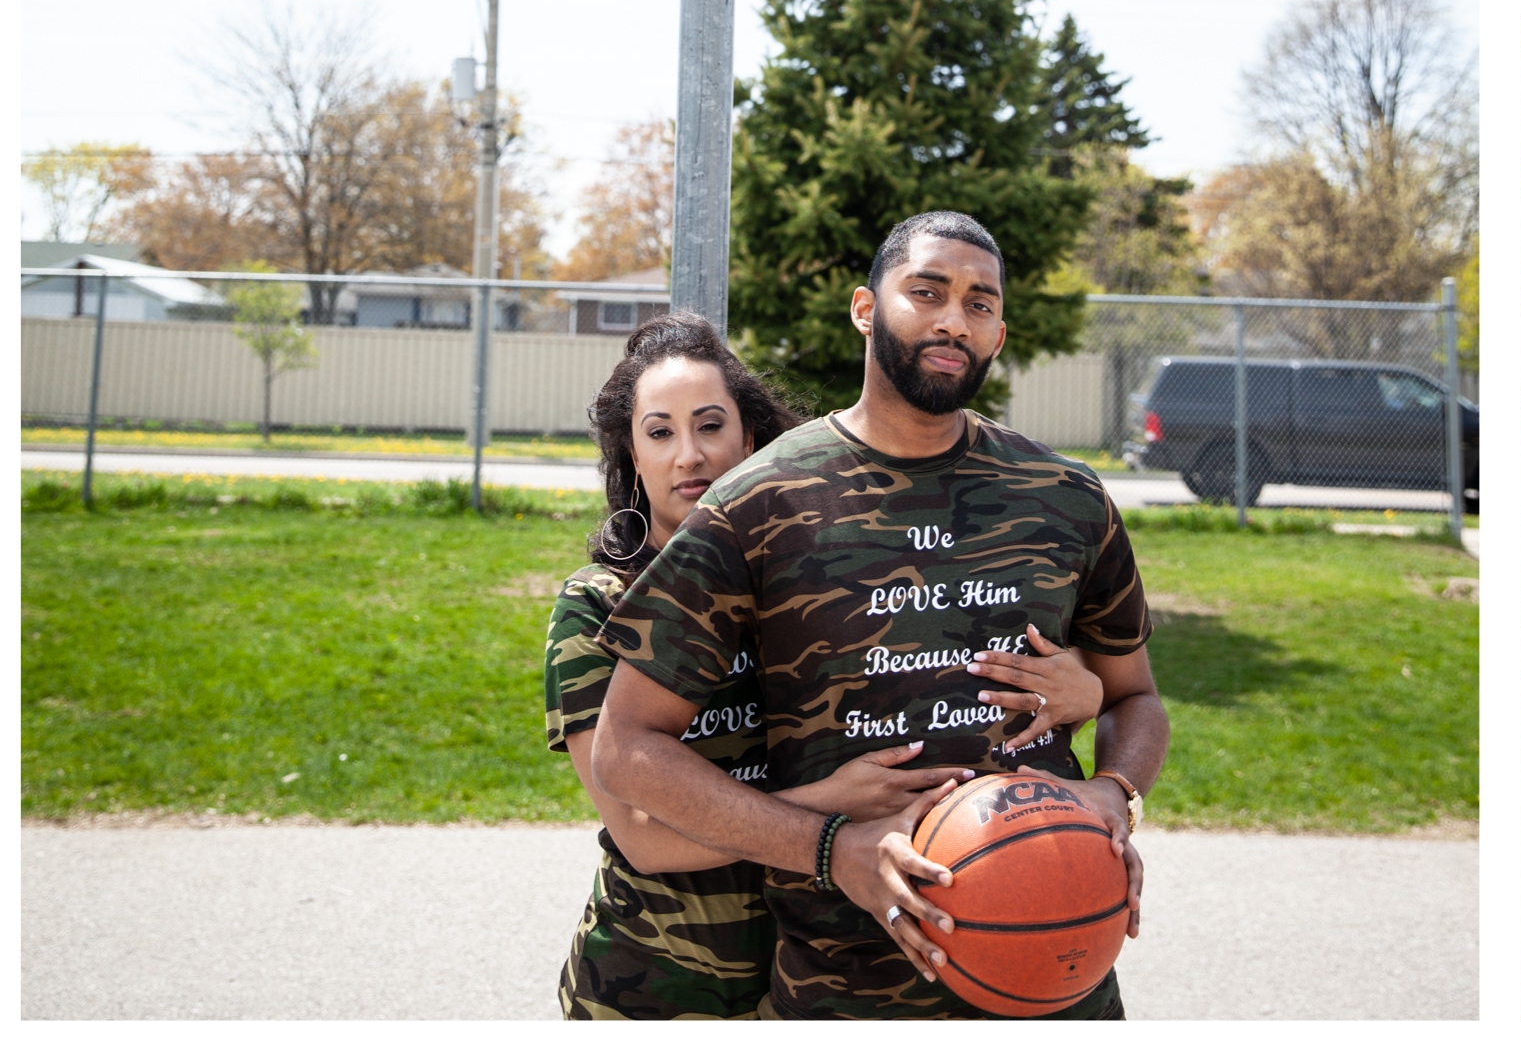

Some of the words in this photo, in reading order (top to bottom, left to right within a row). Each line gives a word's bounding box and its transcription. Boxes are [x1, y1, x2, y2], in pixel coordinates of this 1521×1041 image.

[907, 525, 955, 550] We
[866, 583, 950, 616] LOVE
[957, 580, 1021, 608] Him
[864, 639, 972, 676] Because
[845, 710, 909, 738] First
[972, 781, 1091, 826] NCAA
[1004, 806, 1043, 823] CENTER
[1044, 805, 1075, 813] COURT
